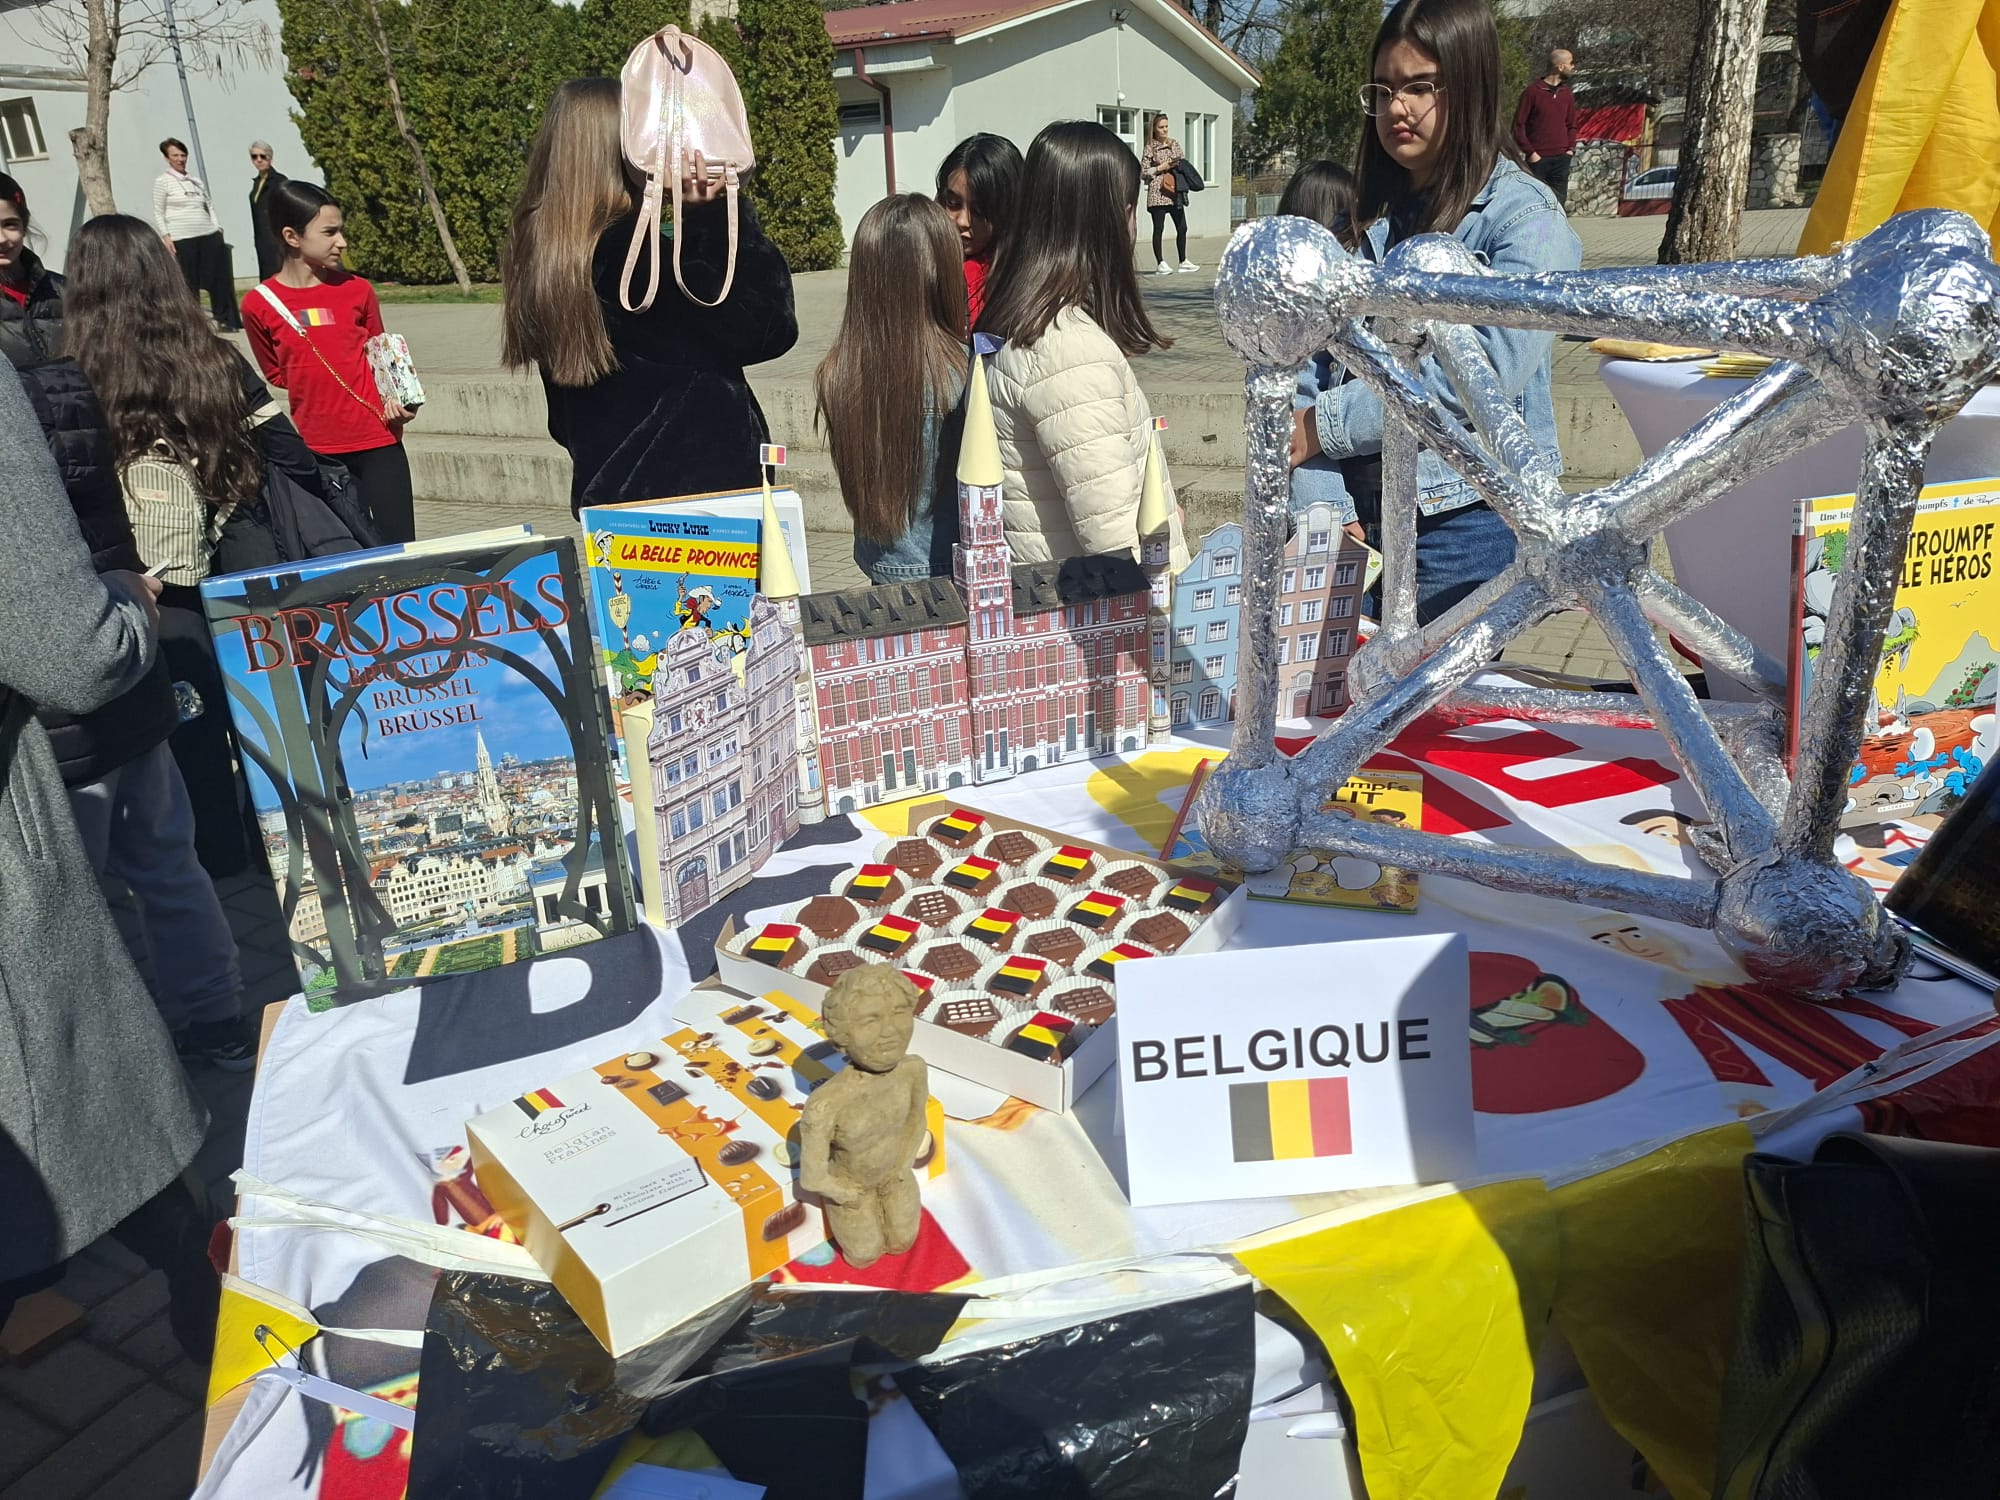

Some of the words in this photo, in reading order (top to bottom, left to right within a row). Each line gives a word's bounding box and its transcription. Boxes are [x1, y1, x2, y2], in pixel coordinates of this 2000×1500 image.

[1819, 512, 1838, 522] Une
[1917, 499, 1949, 511] oumpfs
[1963, 496, 1975, 506] de
[648, 519, 681, 535] LUCKY
[682, 521, 710, 537] LUKE
[1908, 522, 1995, 559] TROUMPF
[620, 543, 638, 561] LA
[640, 543, 683, 564] BELLE
[686, 547, 760, 569] PROVINCE
[1901, 560, 1924, 589] LE
[1930, 551, 1992, 585] HÉROS
[231, 573, 571, 675] BRUSSELS
[348, 647, 490, 688] BRUXELLES
[372, 678, 479, 710] BRUSSEL
[378, 703, 484, 737] BRÜSSEL
[1345, 781, 1410, 792] mpfs
[1131, 1017, 1432, 1083] BELGIQUE
[543, 1126, 611, 1160] Belgian
[546, 1130, 617, 1165] Pralines
